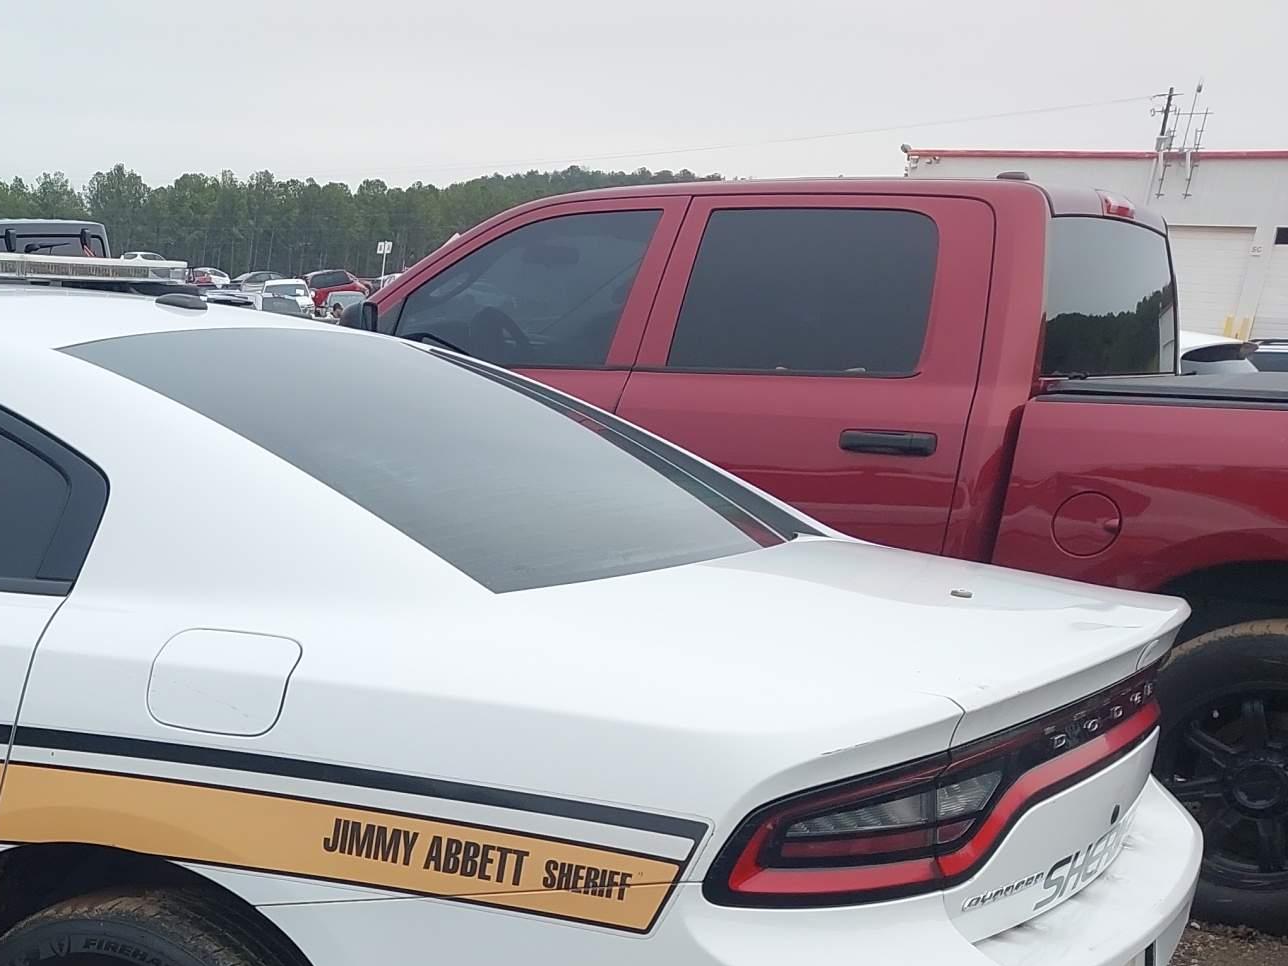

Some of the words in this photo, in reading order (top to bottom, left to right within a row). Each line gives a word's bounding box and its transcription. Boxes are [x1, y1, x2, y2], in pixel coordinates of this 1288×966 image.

[323, 818, 420, 866] JIMMY
[423, 835, 530, 886] ABBETT
[542, 859, 633, 901] SHERIFF
